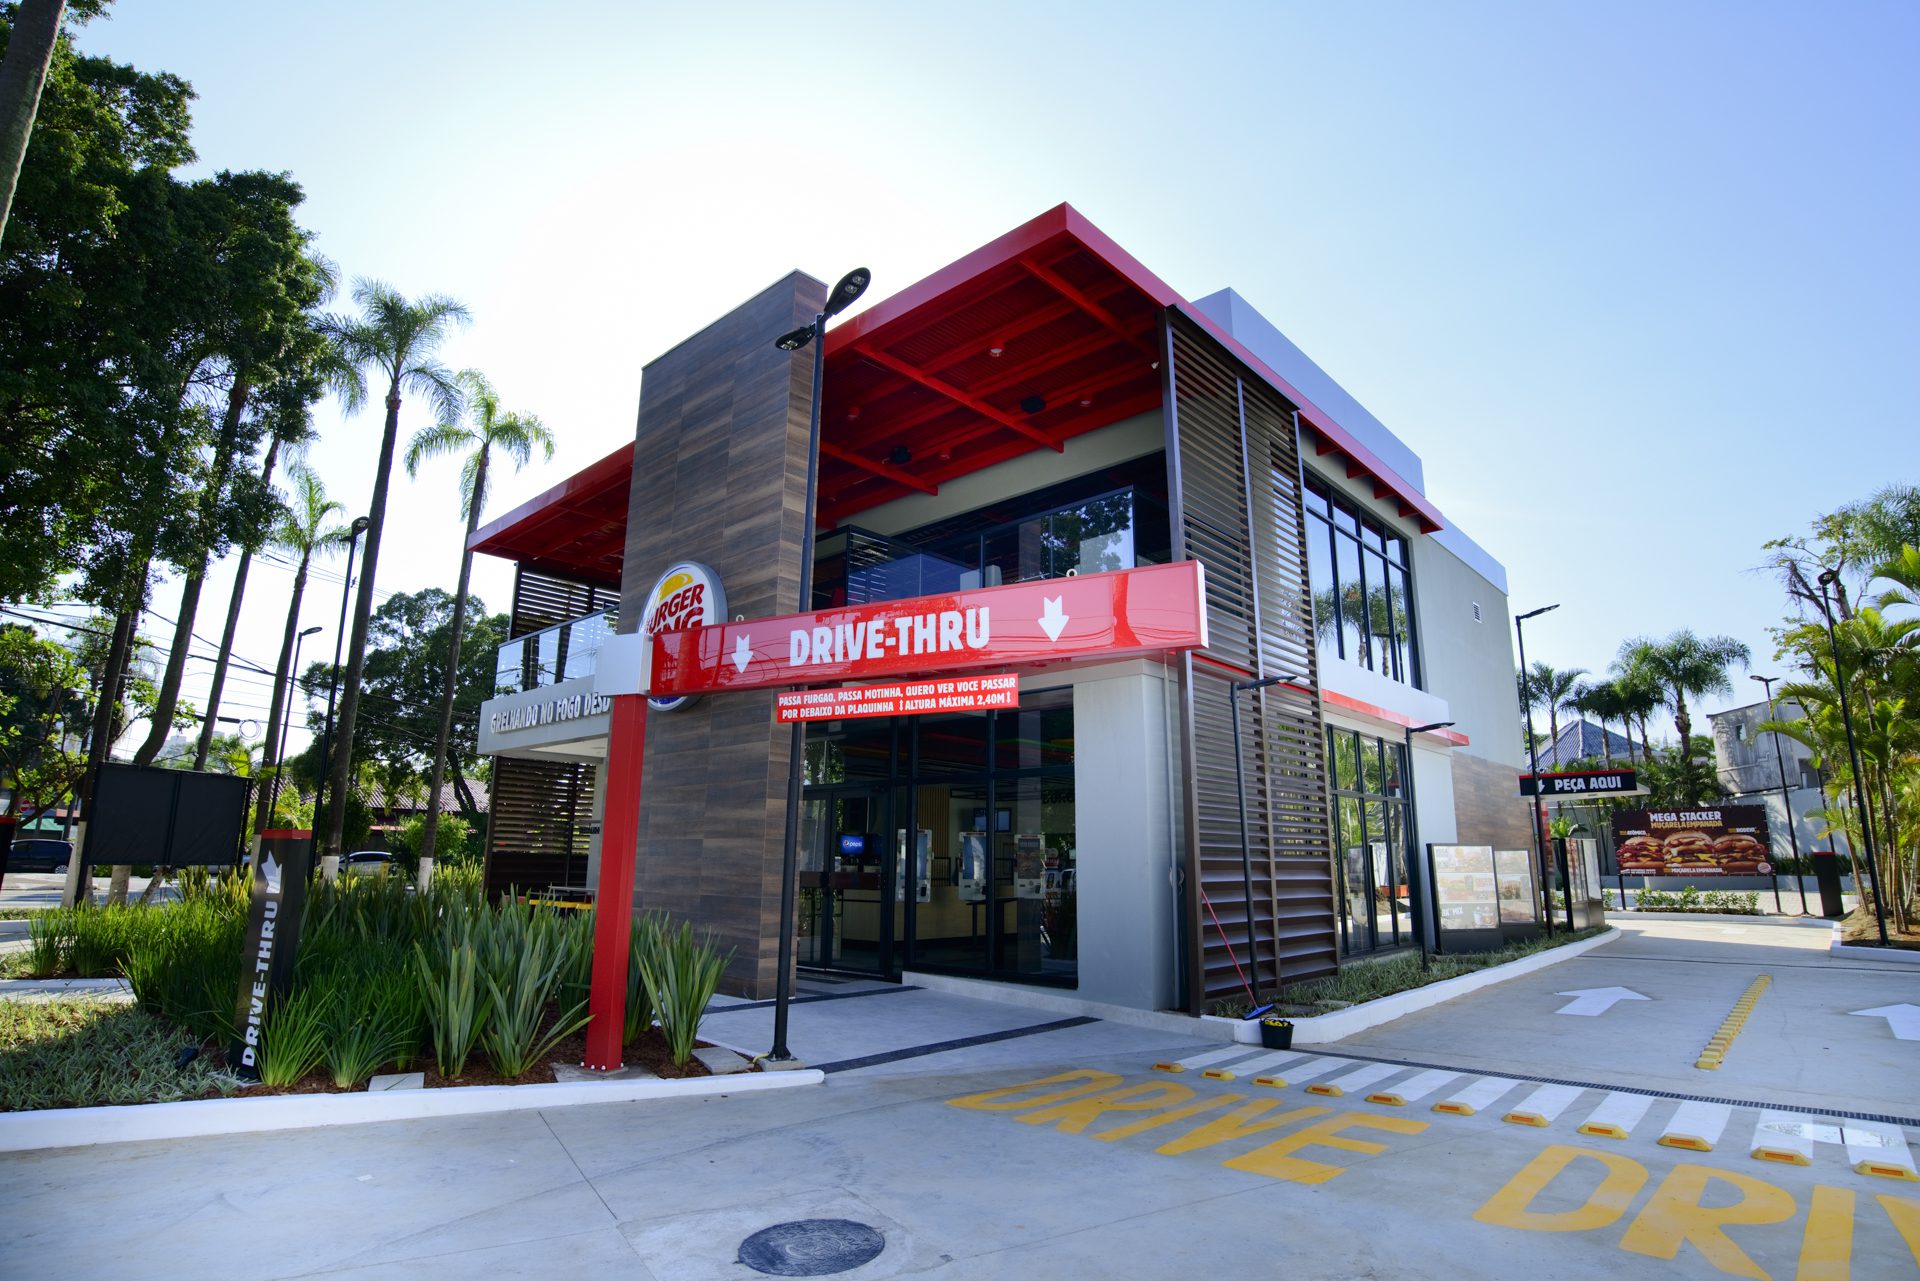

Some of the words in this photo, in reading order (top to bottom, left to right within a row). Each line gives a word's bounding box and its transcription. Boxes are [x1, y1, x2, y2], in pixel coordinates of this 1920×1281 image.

[789, 606, 990, 667] DRIVE-THRU
[779, 695, 801, 706] PASSA
[838, 689, 862, 702] PASSA
[864, 686, 904, 700] MOTINHA,
[905, 684, 935, 697] QUERO
[937, 682, 954, 693] VER
[956, 680, 978, 692] VOCE
[981, 677, 1016, 690] PASSAR
[782, 708, 798, 719] POR
[799, 704, 833, 718] DEBAIXO
[834, 703, 846, 715] DA
[847, 700, 894, 714] PLAQUINHA
[905, 698, 937, 711] ALTURA
[939, 694, 975, 708] MÁXIMA
[977, 692, 1005, 706] 2,40M
[490, 705, 538, 734] GRELHANDO
[540, 700, 554, 725] NO
[555, 694, 581, 722] FOGO
[1554, 777, 1587, 793] PEÇA
[1589, 775, 1623, 790] AQUI
[1649, 812, 1678, 822] MEGA
[1679, 810, 1722, 821] STACKER
[1686, 820, 1723, 828] EMPANADA
[241, 900, 279, 1068] DRIVE-THRU
[944, 1069, 1431, 1185] DRIVE
